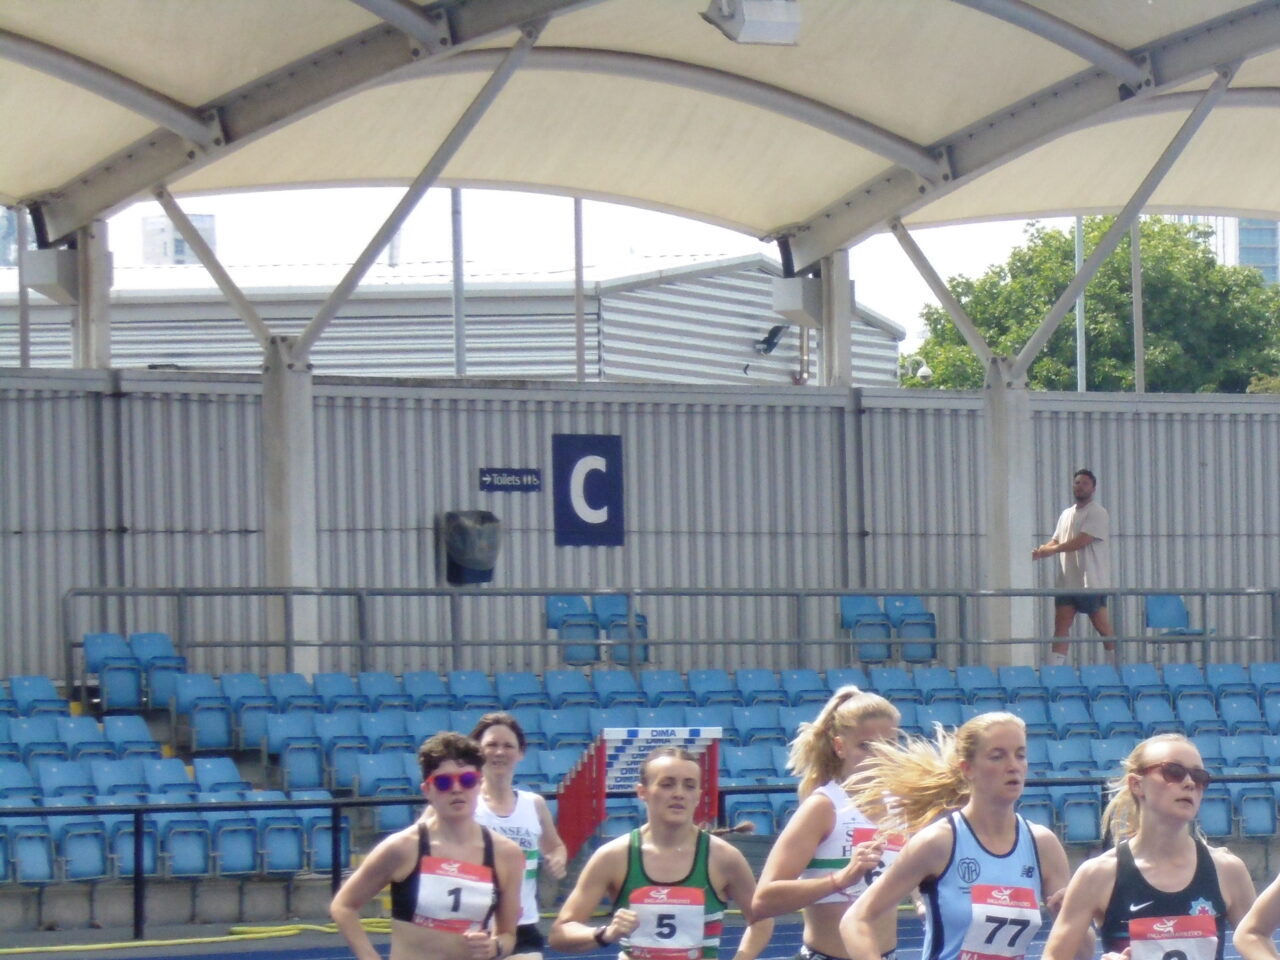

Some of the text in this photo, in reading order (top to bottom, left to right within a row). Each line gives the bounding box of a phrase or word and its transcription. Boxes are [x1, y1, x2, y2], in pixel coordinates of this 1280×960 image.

[492, 473, 521, 486] Toilets
[570, 455, 608, 524] C
[651, 729, 677, 737] DIMA
[447, 887, 463, 912] 1
[655, 914, 677, 939] 5
[984, 915, 1031, 947] 77
